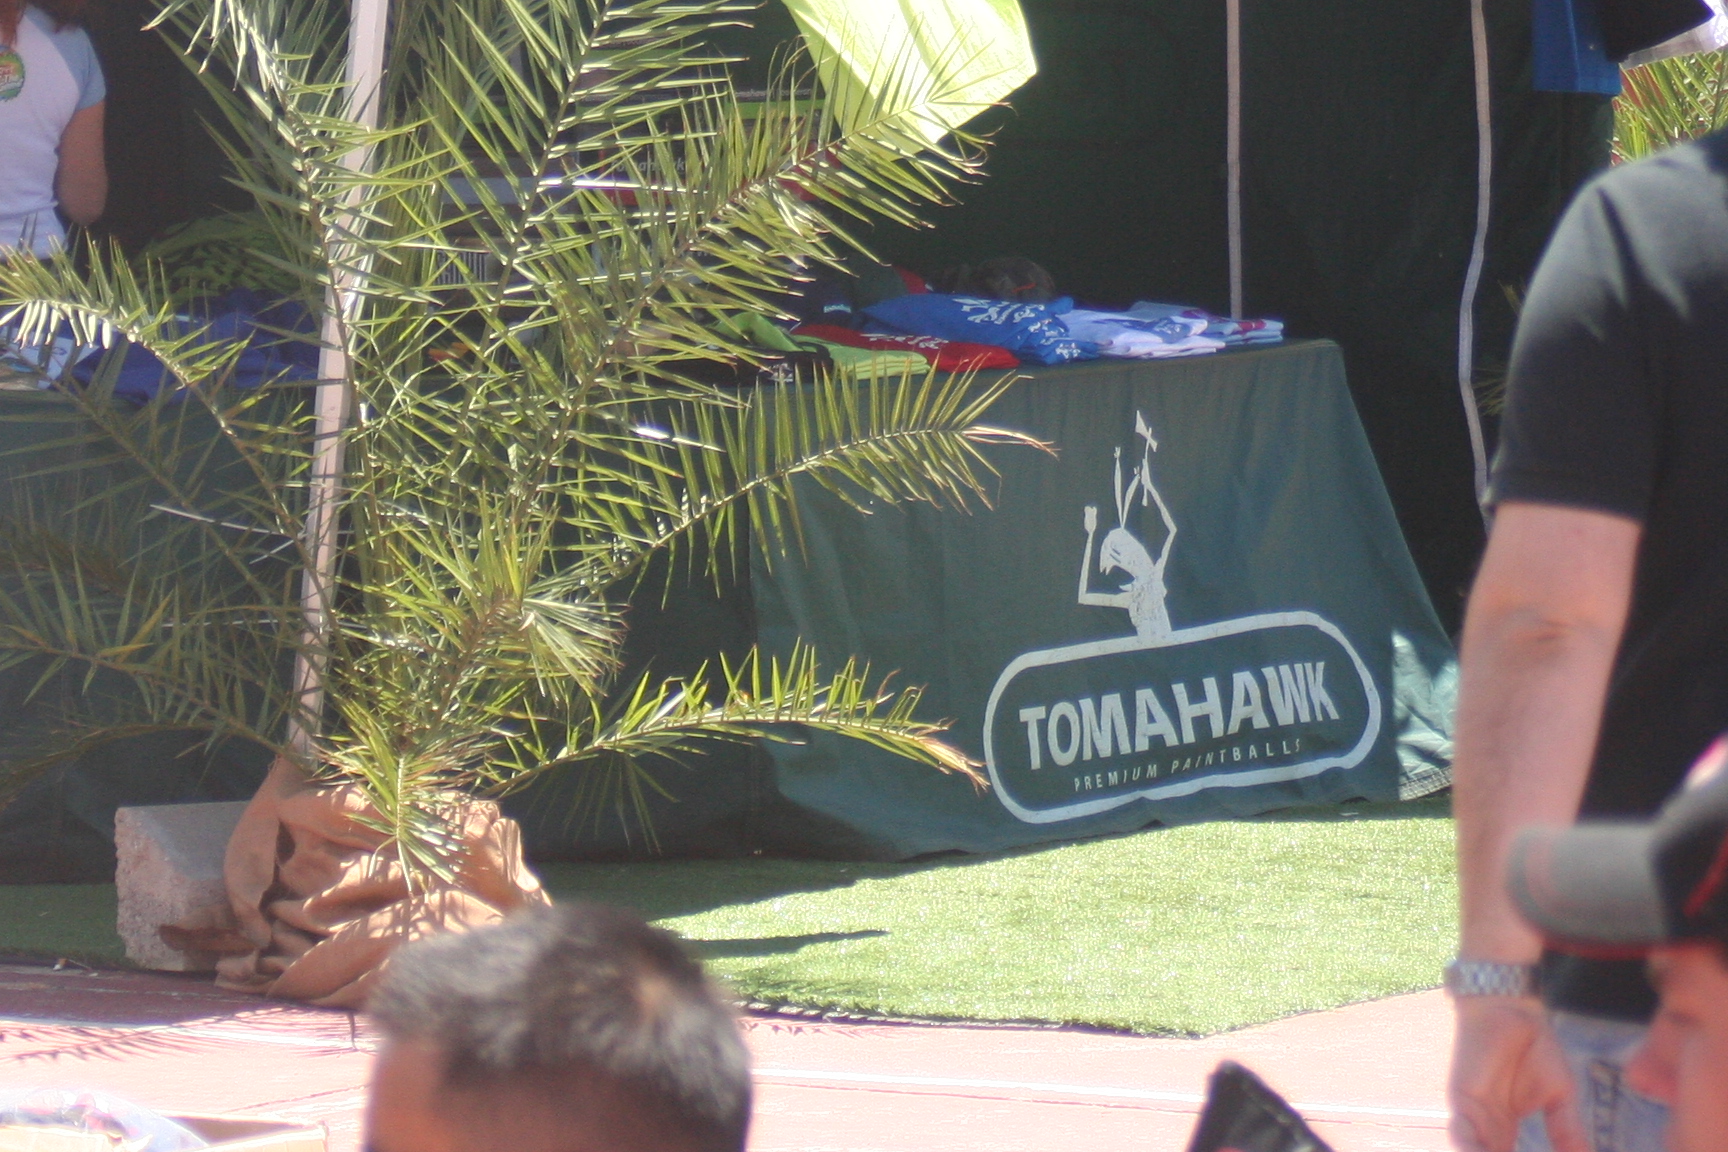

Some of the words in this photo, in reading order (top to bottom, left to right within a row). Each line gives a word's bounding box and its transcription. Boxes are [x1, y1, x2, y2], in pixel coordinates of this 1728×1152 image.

[1019, 661, 1340, 771] TOMAHAWK
[1074, 763, 1159, 792] PREMIUM
[1171, 738, 1302, 775] PAINTBALLS
